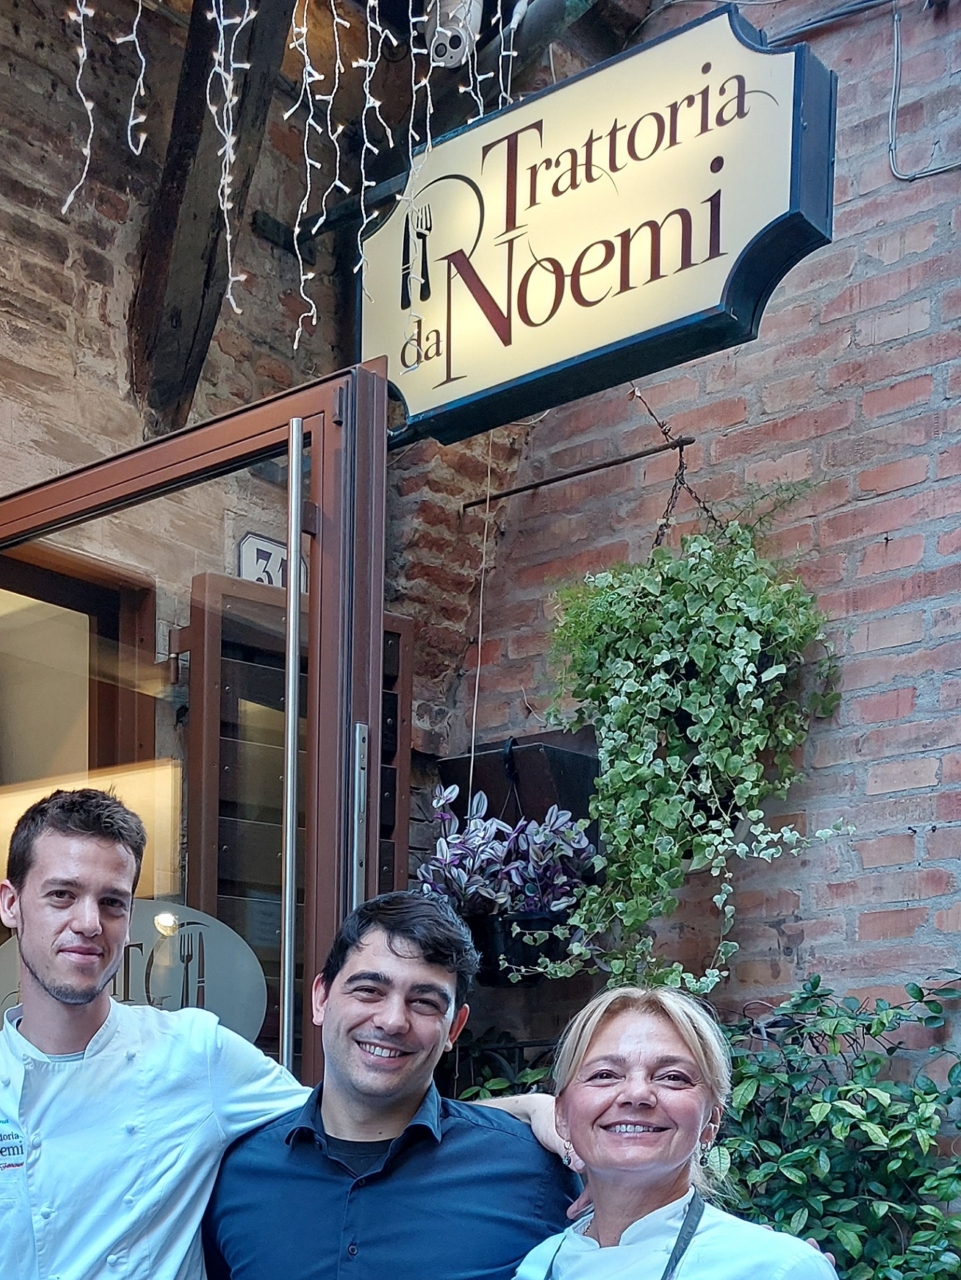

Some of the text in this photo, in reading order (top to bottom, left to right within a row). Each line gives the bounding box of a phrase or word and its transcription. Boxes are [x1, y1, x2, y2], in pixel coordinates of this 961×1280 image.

[481, 61, 779, 240] Trattoria
[400, 156, 728, 390] da Noemi
